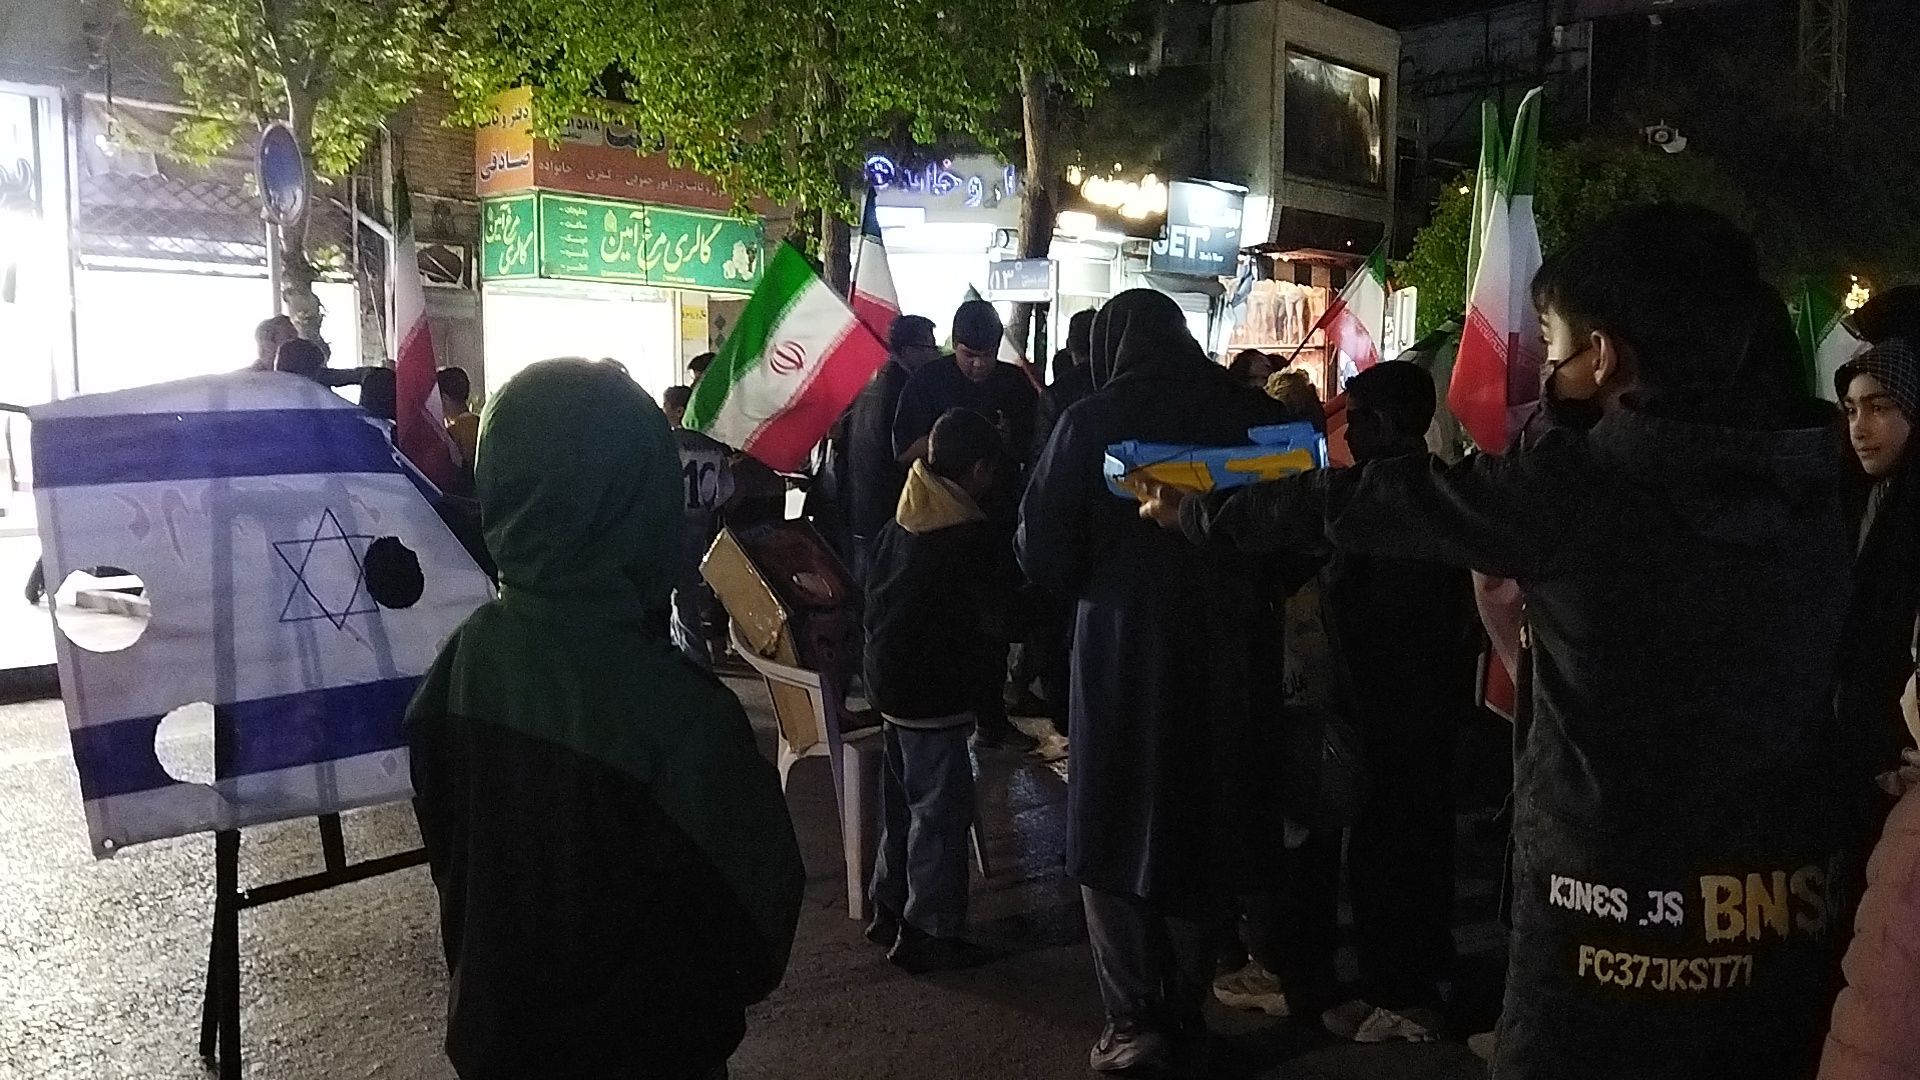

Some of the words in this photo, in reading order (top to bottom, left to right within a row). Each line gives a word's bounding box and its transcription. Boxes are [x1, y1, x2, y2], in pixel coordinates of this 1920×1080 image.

[480, 149, 530, 181] صادقی
[499, 231, 534, 275] گالری
[600, 210, 650, 263] آمین
[636, 227, 667, 272] مرغ
[663, 222, 723, 273] گالری
[681, 460, 717, 511] 10
